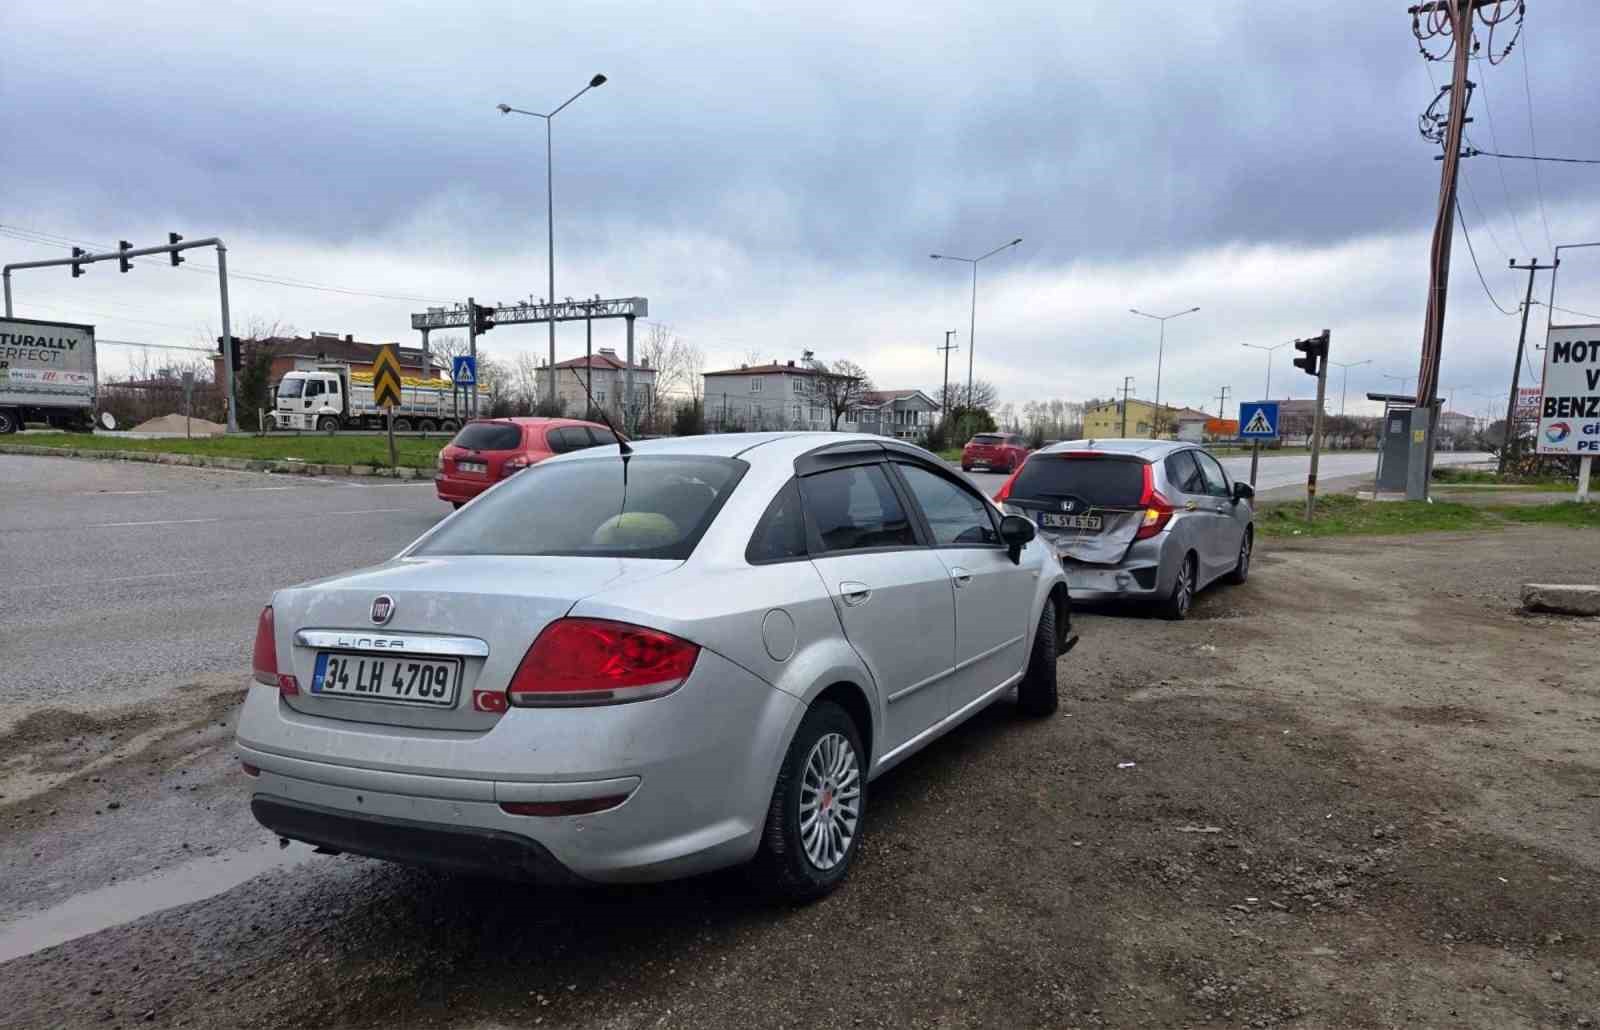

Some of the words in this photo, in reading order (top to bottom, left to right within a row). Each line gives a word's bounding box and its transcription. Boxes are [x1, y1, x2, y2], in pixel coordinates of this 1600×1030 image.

[1543, 396, 1600, 418] BENZ
[1577, 440, 1600, 451] PE
[374, 603, 390, 617] FIAT
[337, 637, 404, 648] LINEA
[325, 658, 349, 690] 34
[355, 660, 384, 693] LH
[392, 663, 449, 698] 4709
